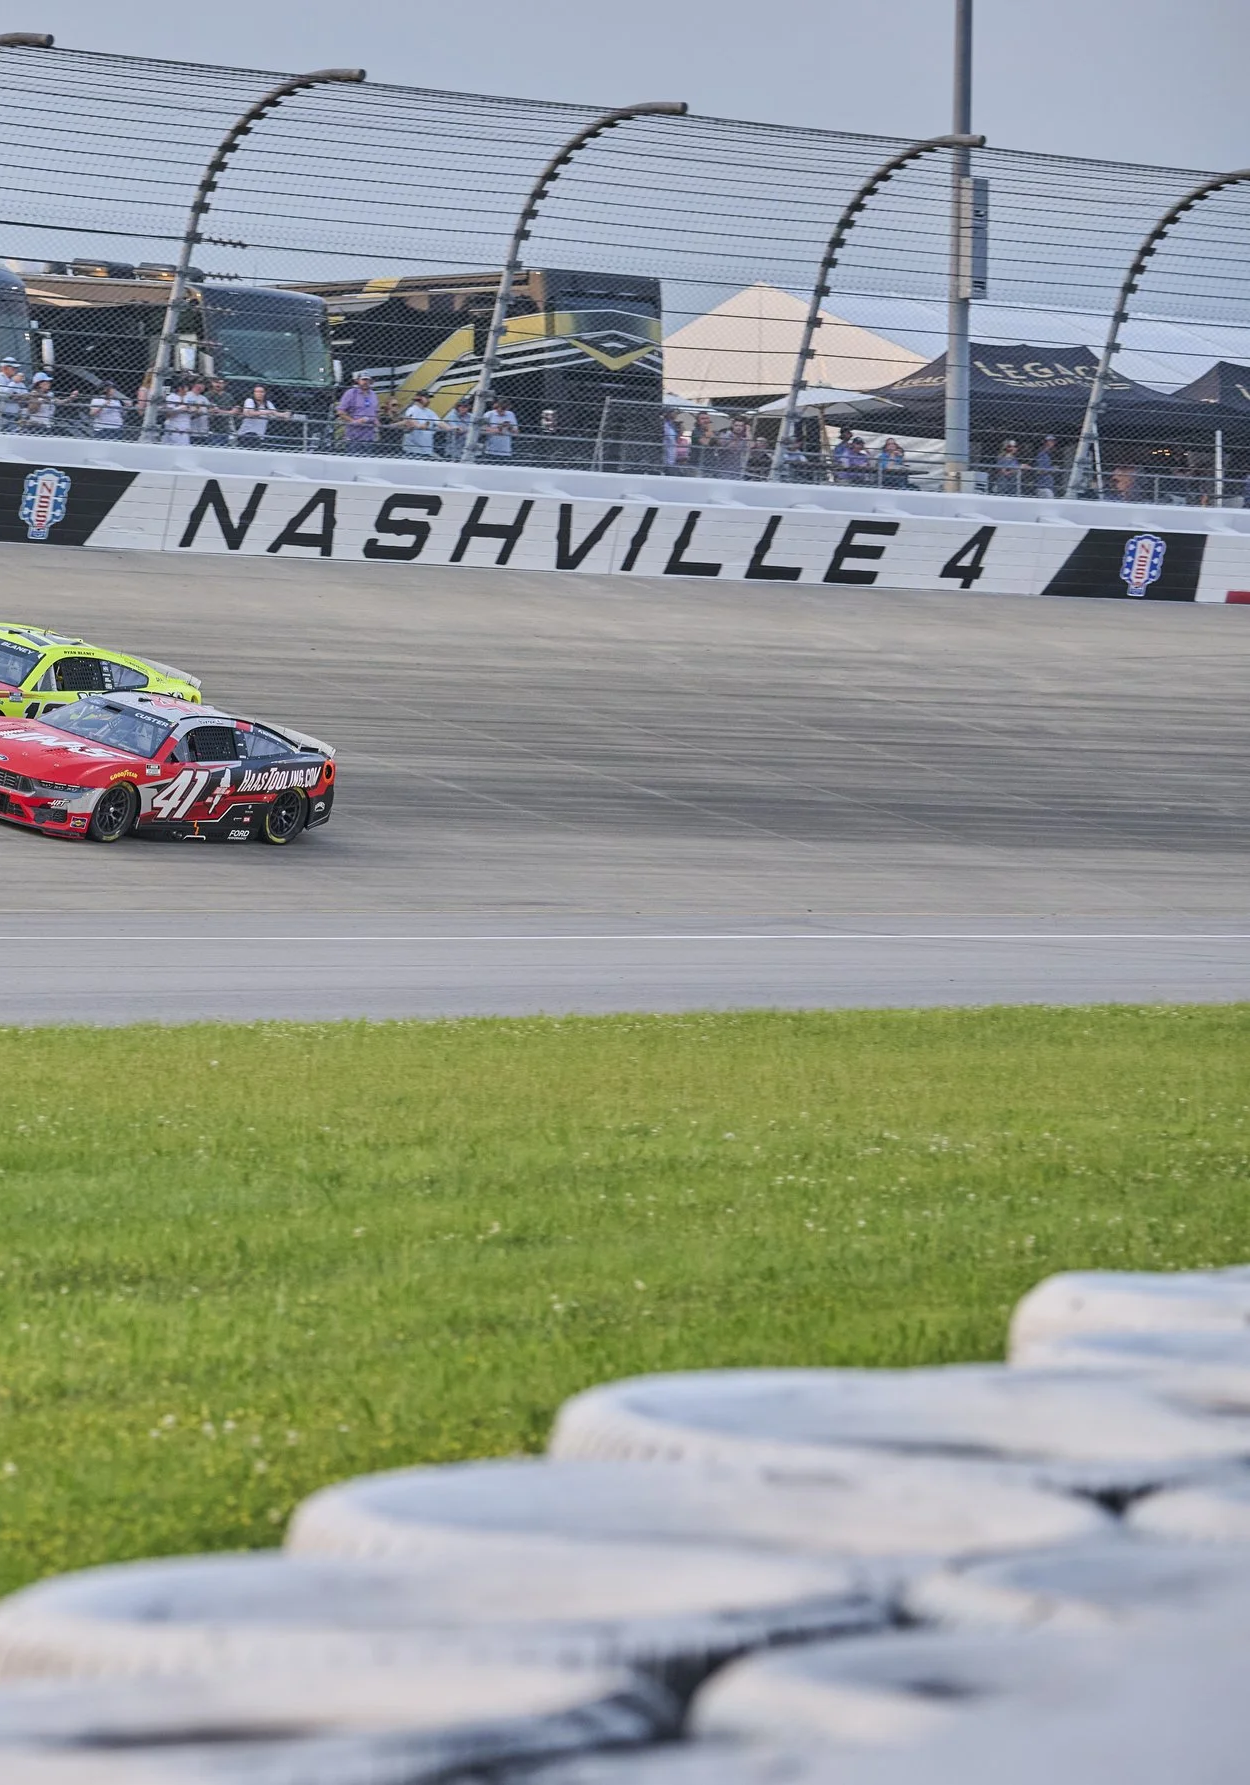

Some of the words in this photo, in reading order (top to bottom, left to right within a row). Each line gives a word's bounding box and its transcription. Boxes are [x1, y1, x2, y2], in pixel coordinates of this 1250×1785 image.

[179, 480, 899, 584] NASHVILLE
[940, 526, 996, 588] 4
[1, 641, 35, 655] BLANEY
[135, 712, 170, 728] CUSTER
[110, 769, 138, 781] GOODYEAR
[152, 769, 210, 820] 41
[229, 829, 250, 837] FORD
